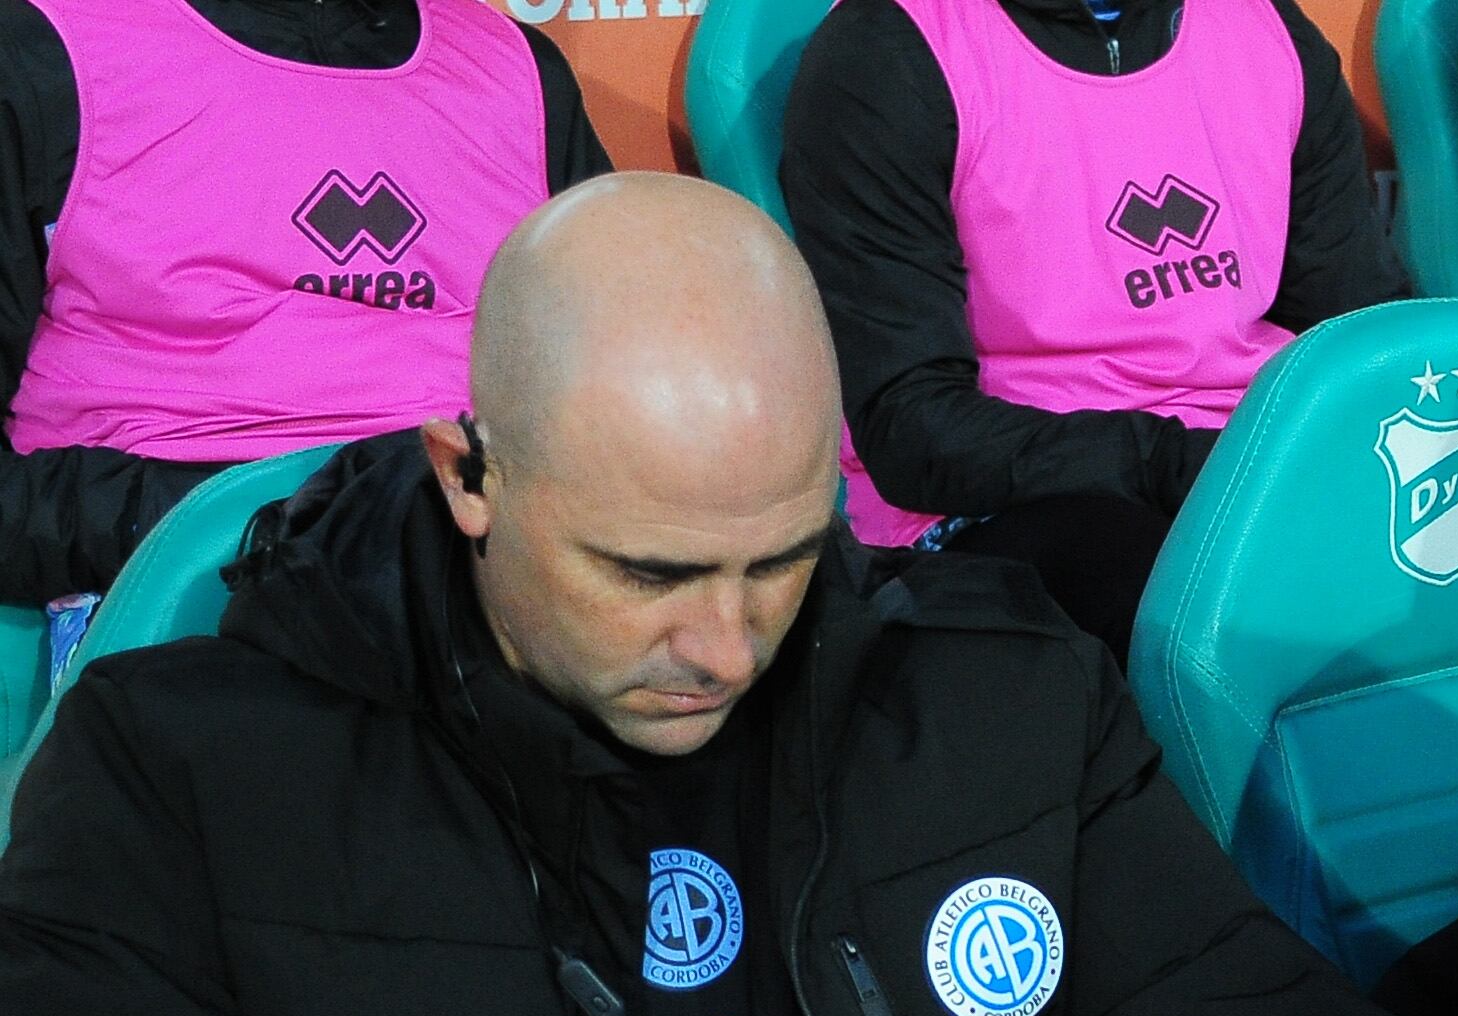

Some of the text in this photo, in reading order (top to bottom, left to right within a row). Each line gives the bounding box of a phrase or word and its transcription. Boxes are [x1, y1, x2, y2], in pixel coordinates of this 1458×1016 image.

[689, 855, 741, 934] BELGRANO
[650, 954, 730, 983] CORDOBA
[935, 884, 1060, 1006] CLUB ATLETICO BELGRANO
